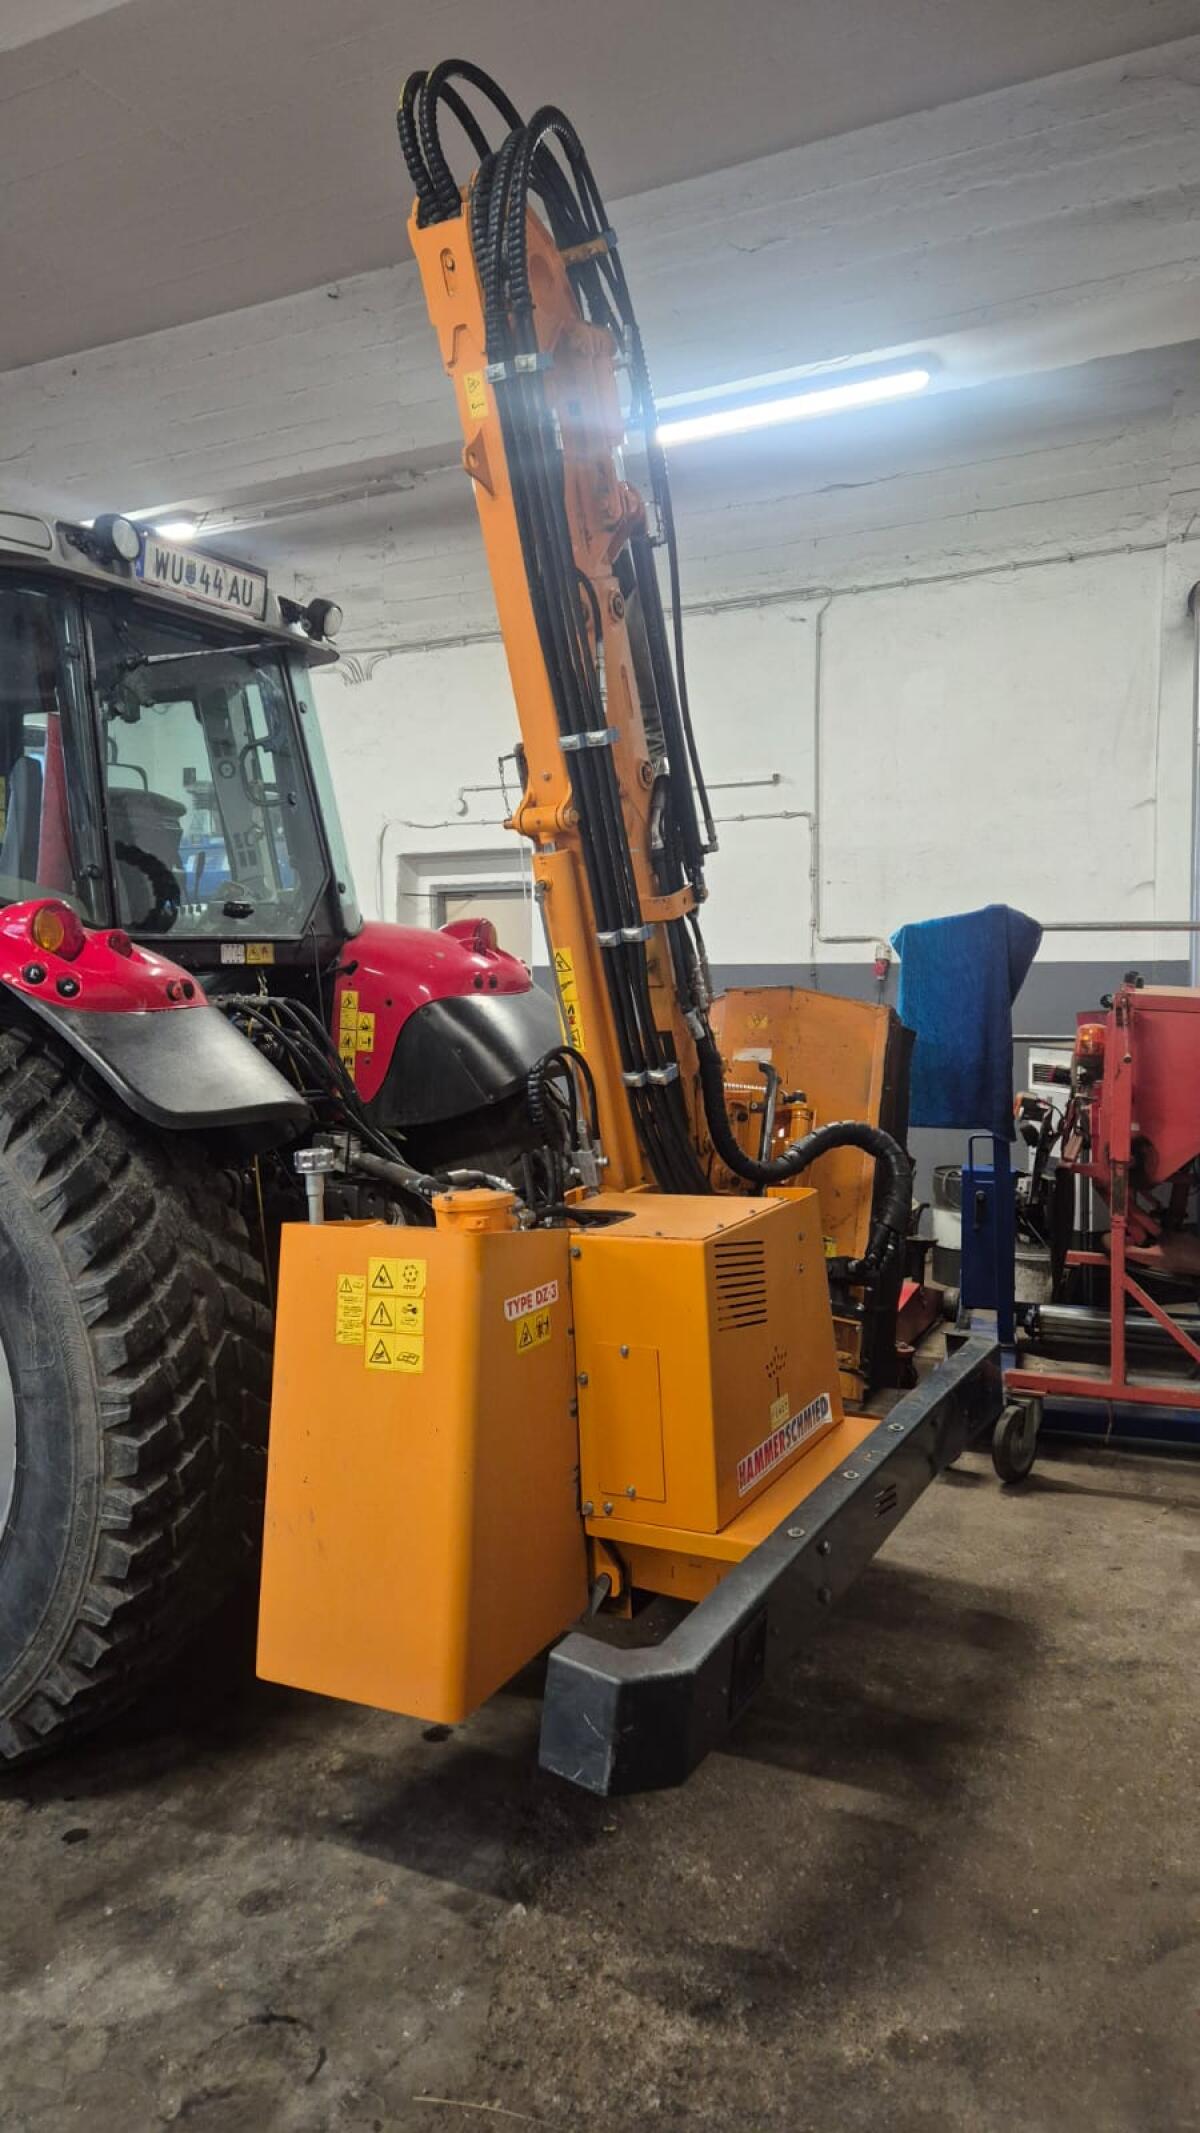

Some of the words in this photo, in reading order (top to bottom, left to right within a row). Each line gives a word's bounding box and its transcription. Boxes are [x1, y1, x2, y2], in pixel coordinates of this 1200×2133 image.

[155, 547, 184, 584] WU
[200, 564, 222, 598] 44
[227, 575, 253, 607] AU
[506, 1293, 533, 1317] TYPE
[738, 1396, 829, 1489] HAMMERSCHMIED
